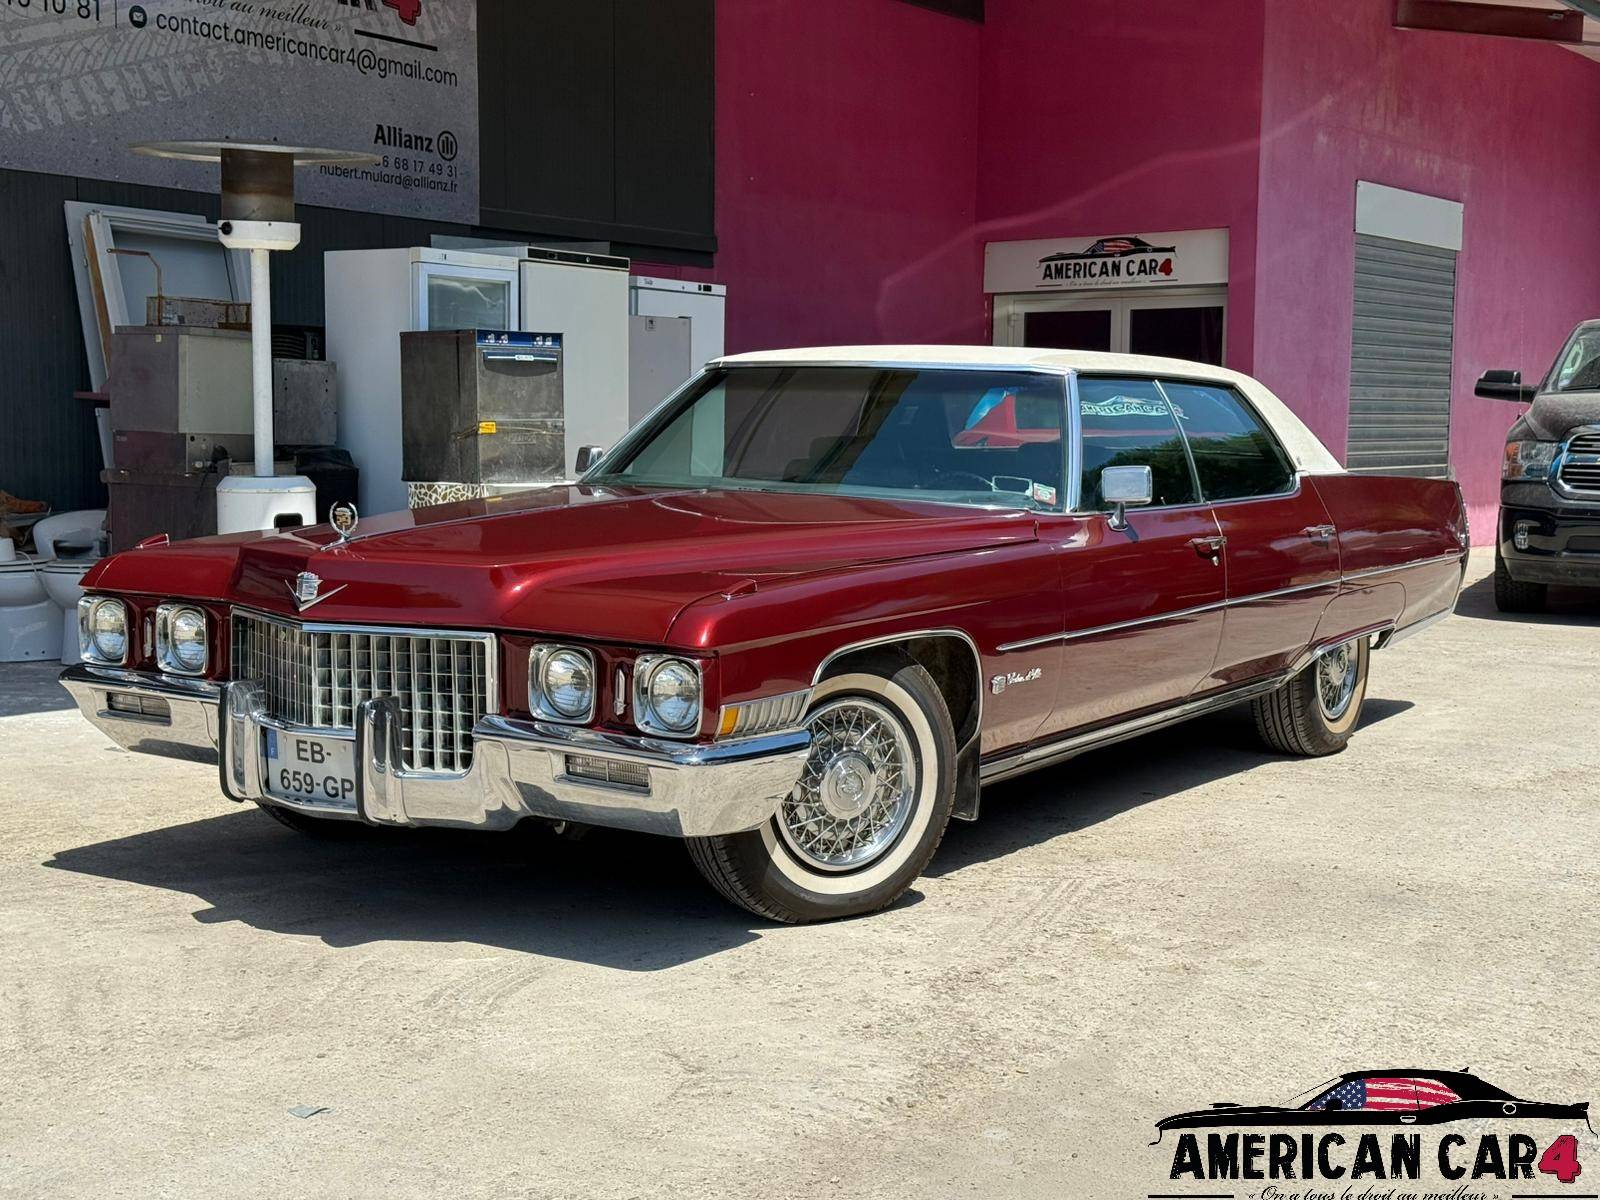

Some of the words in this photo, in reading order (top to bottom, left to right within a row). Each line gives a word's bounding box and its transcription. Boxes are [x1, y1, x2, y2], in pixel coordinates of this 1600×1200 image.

[231, 1, 254, 14] au
[260, 2, 330, 30] meilleur
[156, 13, 458, 87] contact.americancar4@gmail.com
[374, 124, 433, 153] Allianz
[374, 155, 390, 168] 6
[394, 157, 409, 171] 68
[413, 160, 424, 173] 17
[429, 163, 443, 176] 49
[447, 165, 458, 178] 31
[1042, 260, 1122, 281] AMERICAN
[1125, 258, 1173, 277] CAR4
[280, 768, 355, 800] 659-GP
